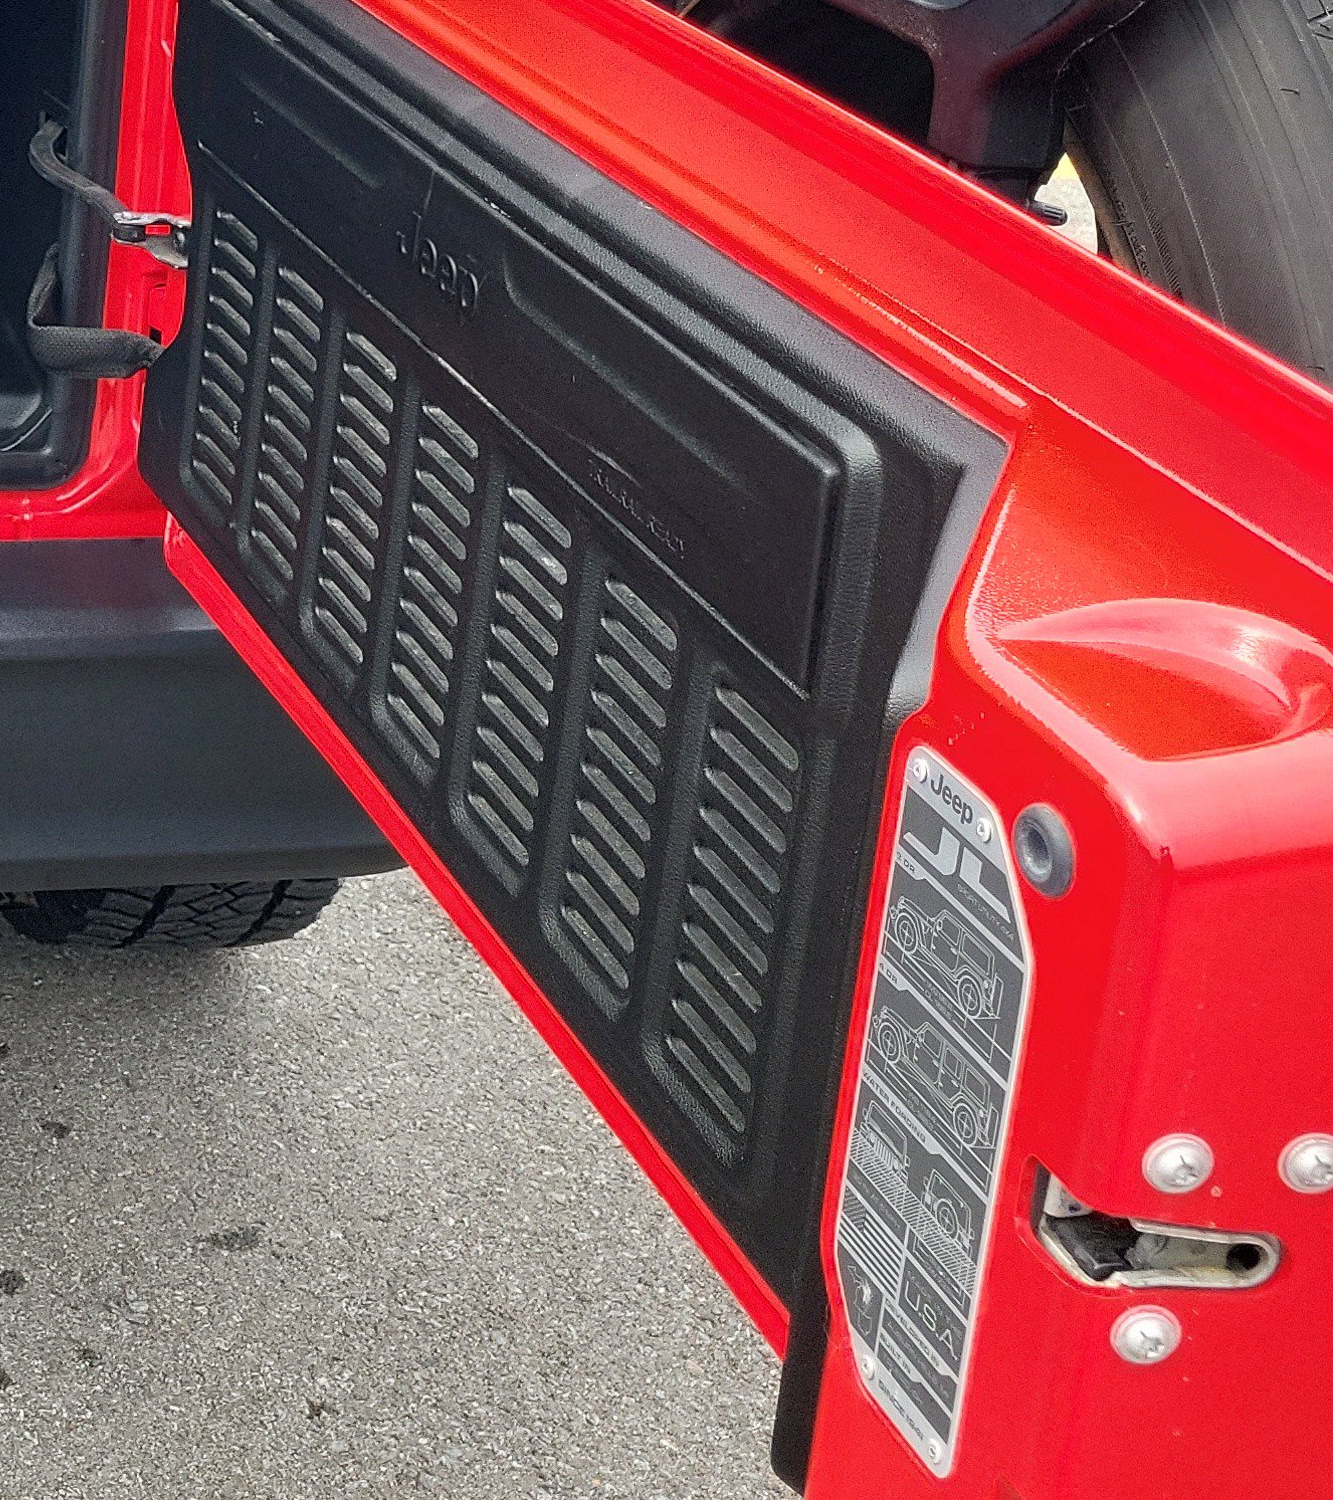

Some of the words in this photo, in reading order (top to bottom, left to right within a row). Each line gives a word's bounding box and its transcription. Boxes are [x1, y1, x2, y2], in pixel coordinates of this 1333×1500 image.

[395, 211, 480, 320] Jeep
[930, 773, 974, 825] Jeep
[903, 860, 916, 873] DR
[903, 825, 1011, 923] JL
[886, 970, 898, 984] DR
[863, 1071, 890, 1103] WATER
[890, 1102, 926, 1143] FORDING
[880, 1332, 901, 1360] BUILT
[904, 1280, 958, 1361] U.S.A.
[878, 1380, 905, 1417] SINCE
